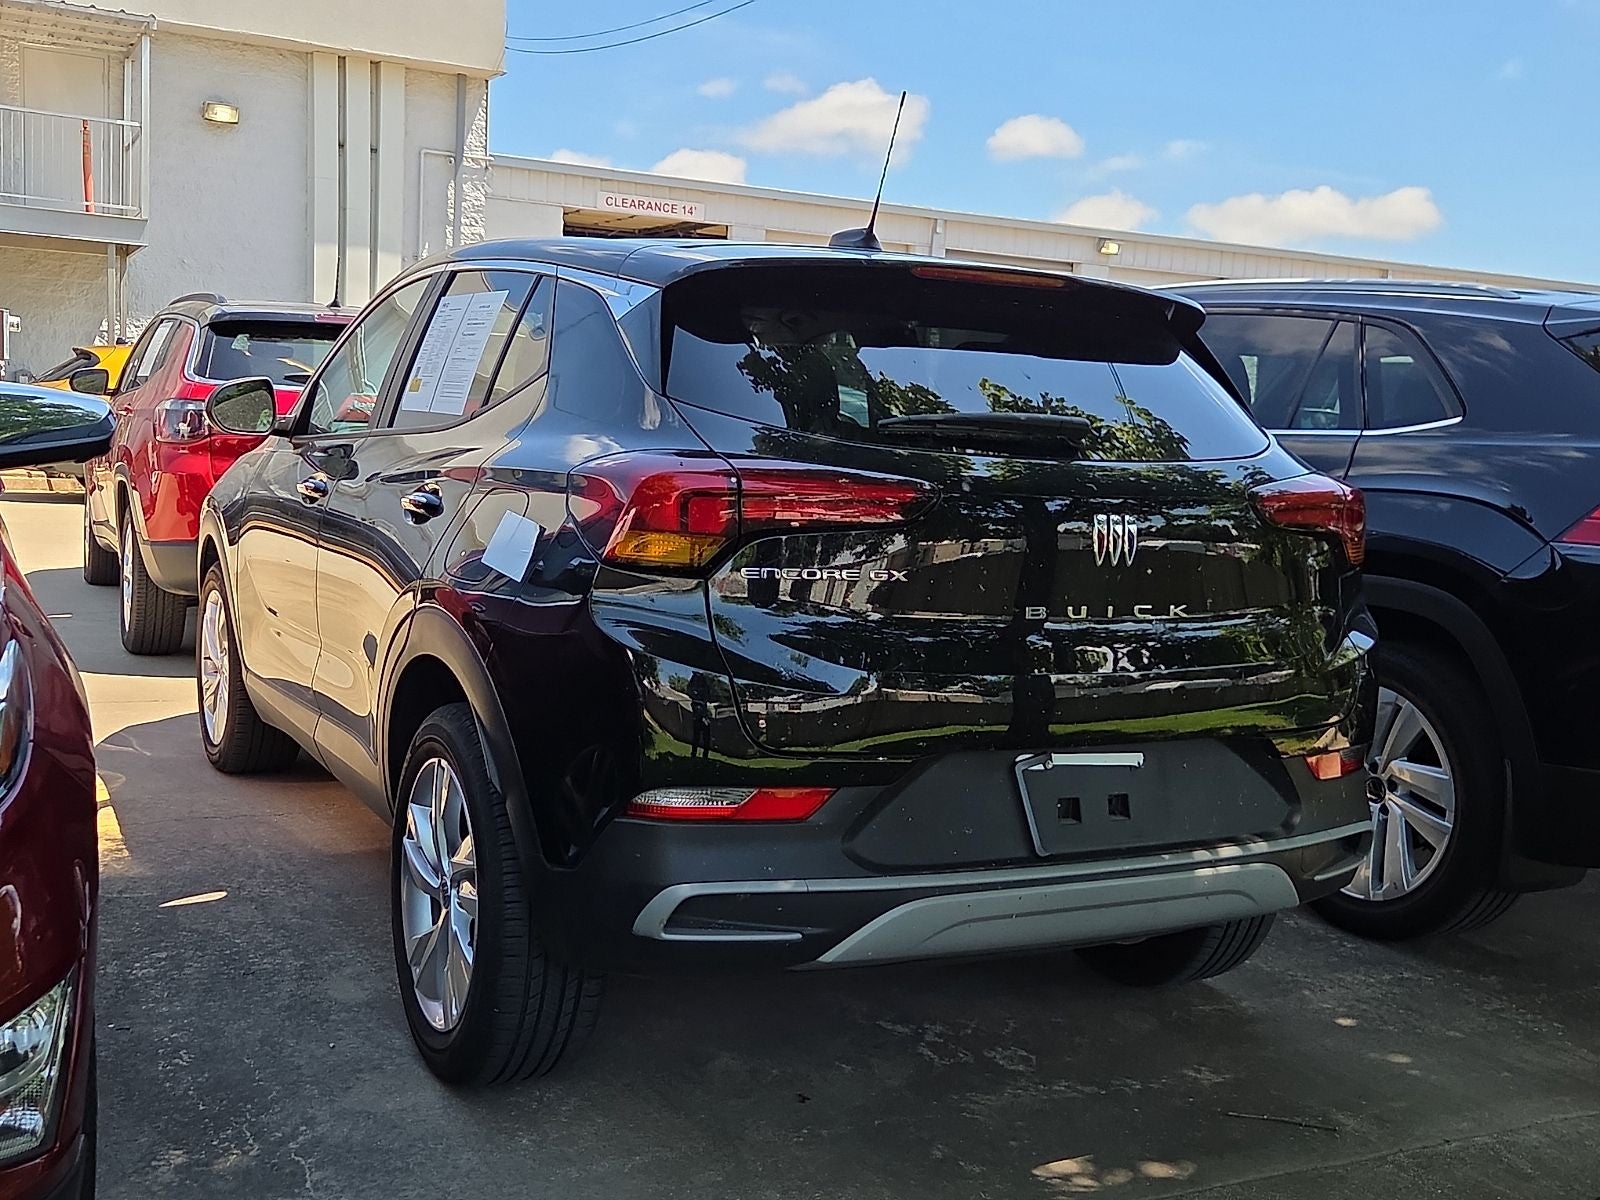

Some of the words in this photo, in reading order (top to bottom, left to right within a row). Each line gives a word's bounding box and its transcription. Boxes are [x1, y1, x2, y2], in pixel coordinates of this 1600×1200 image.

[605, 196, 678, 214] CLEARANCE
[682, 205, 697, 216] 14'
[740, 567, 861, 581] ENCORE
[869, 569, 909, 582] GX
[1025, 604, 1189, 620] BUICK
